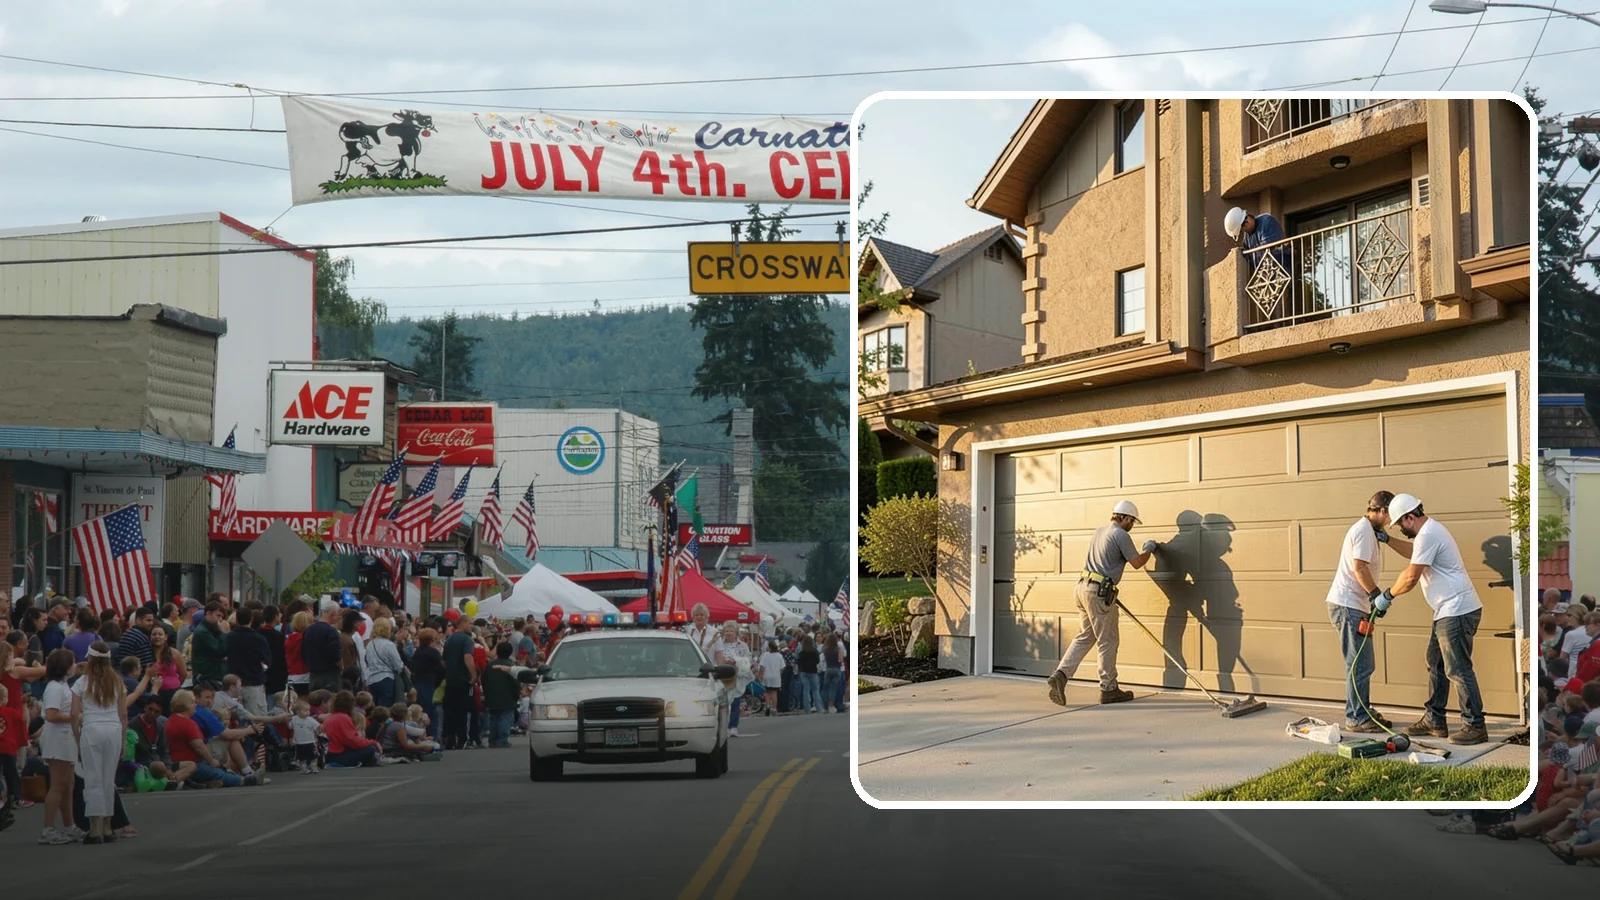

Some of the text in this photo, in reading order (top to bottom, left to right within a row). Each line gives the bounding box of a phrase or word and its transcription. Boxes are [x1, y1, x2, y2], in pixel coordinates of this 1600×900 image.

[481, 141, 604, 192] JULY
[632, 150, 746, 197] 4th.
[697, 254, 850, 279] CROSSWA
[283, 380, 373, 420] ACE
[406, 409, 485, 422] CEDAR LOG
[284, 421, 370, 436] Hardware
[416, 428, 477, 446] Coca-Cola
[83, 485, 155, 495] St. Vincent de Paul
[699, 535, 730, 543] GLASS
